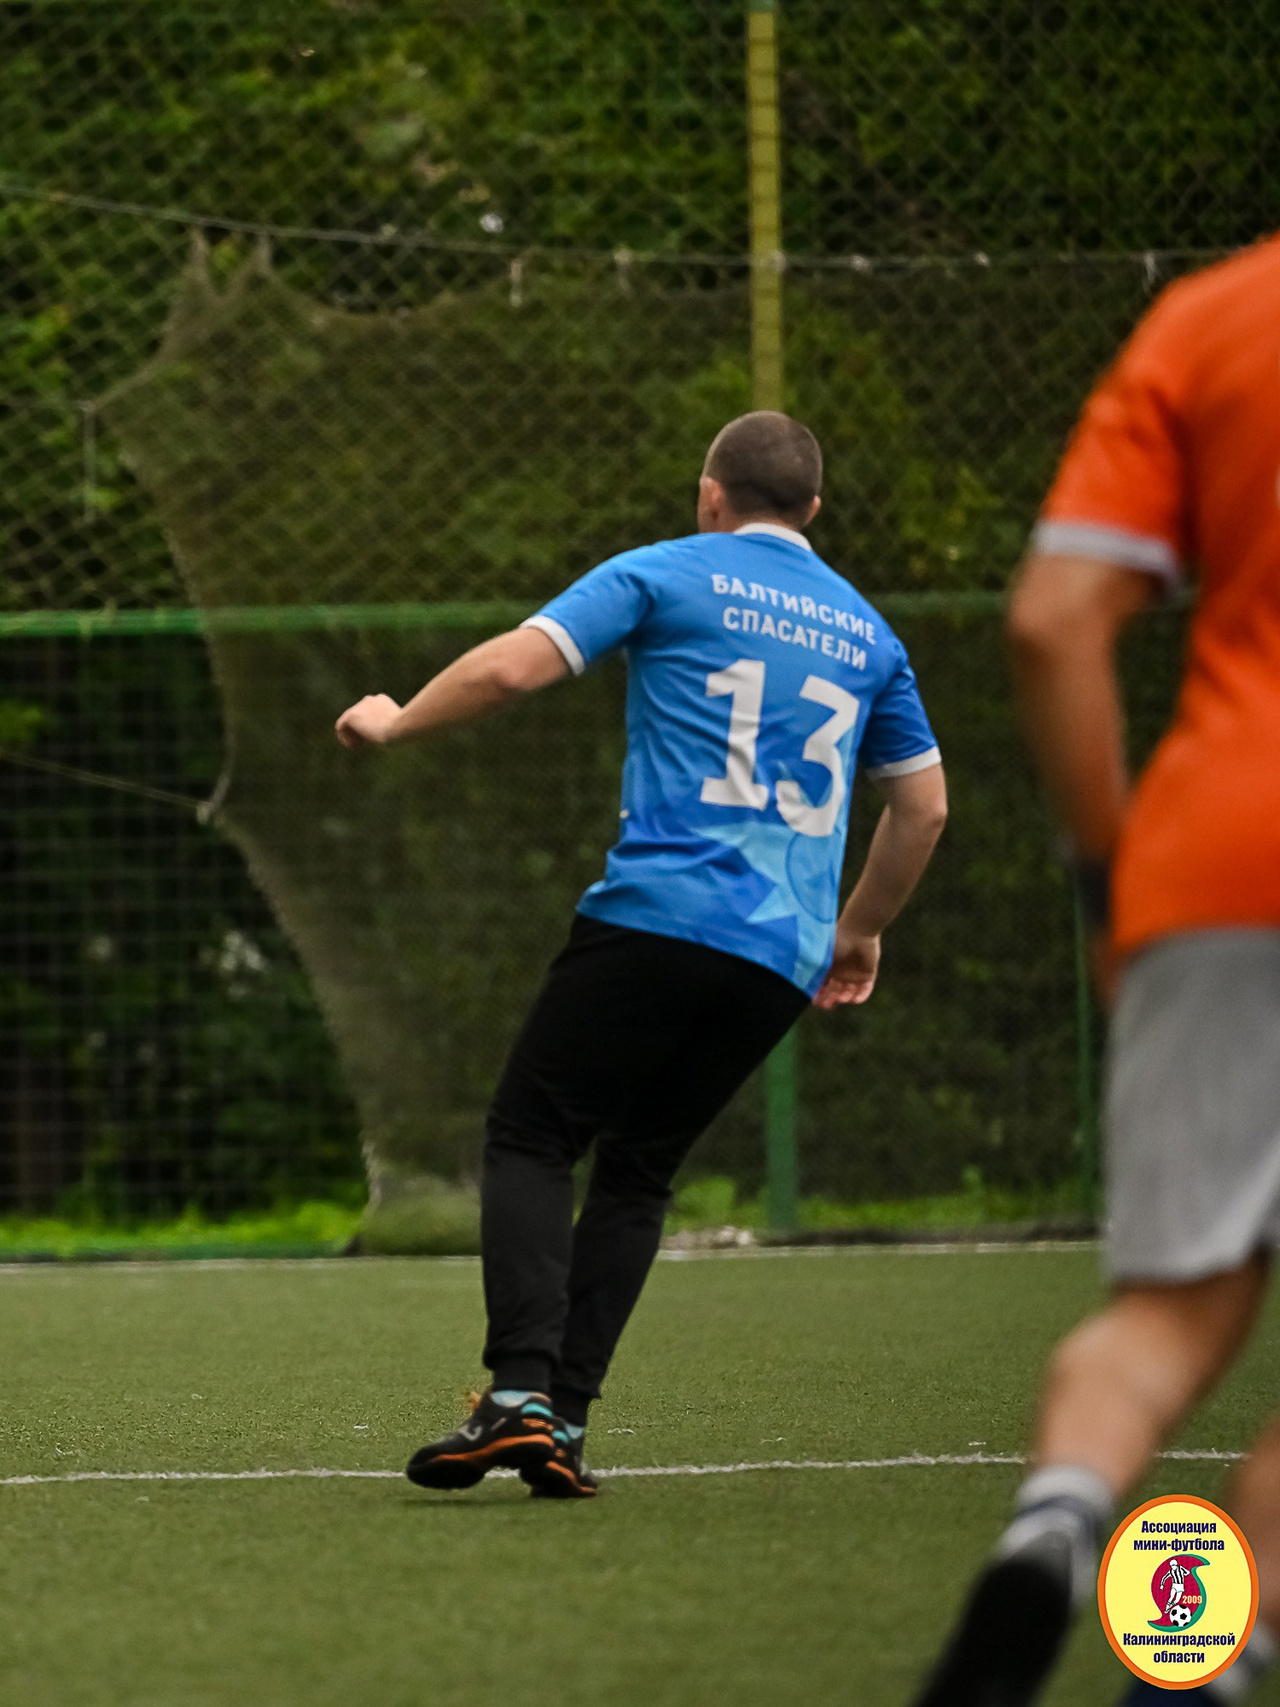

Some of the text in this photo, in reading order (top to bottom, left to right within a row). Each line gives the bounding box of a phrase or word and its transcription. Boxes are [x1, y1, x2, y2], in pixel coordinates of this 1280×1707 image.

[710, 573, 877, 646] БАЛТИЙСКИЕ
[723, 606, 867, 671] СПАСАТЕЛИ
[700, 658, 860, 838] 13
